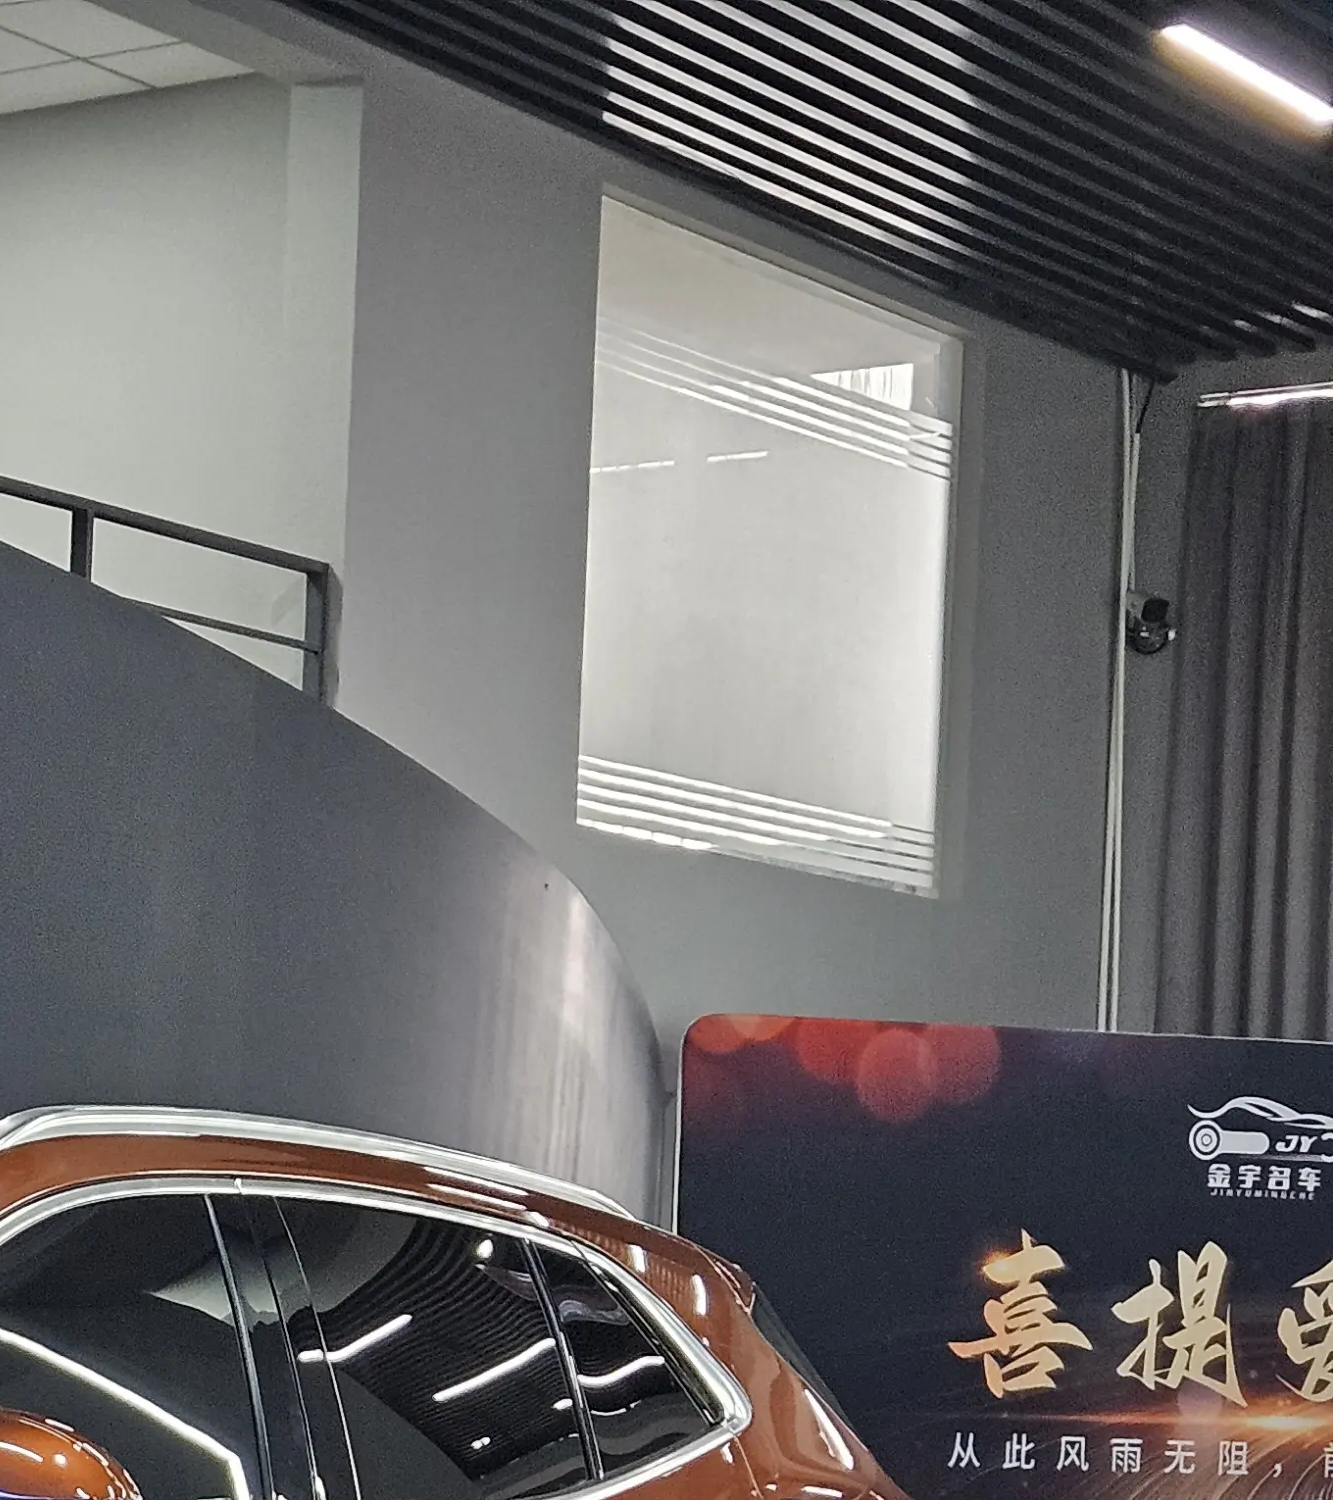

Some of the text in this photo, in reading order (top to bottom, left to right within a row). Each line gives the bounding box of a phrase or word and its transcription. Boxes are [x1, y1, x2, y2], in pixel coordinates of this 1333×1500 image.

[1275, 1134, 1318, 1153] JY
[1207, 1163, 1322, 1192] 金宇名车
